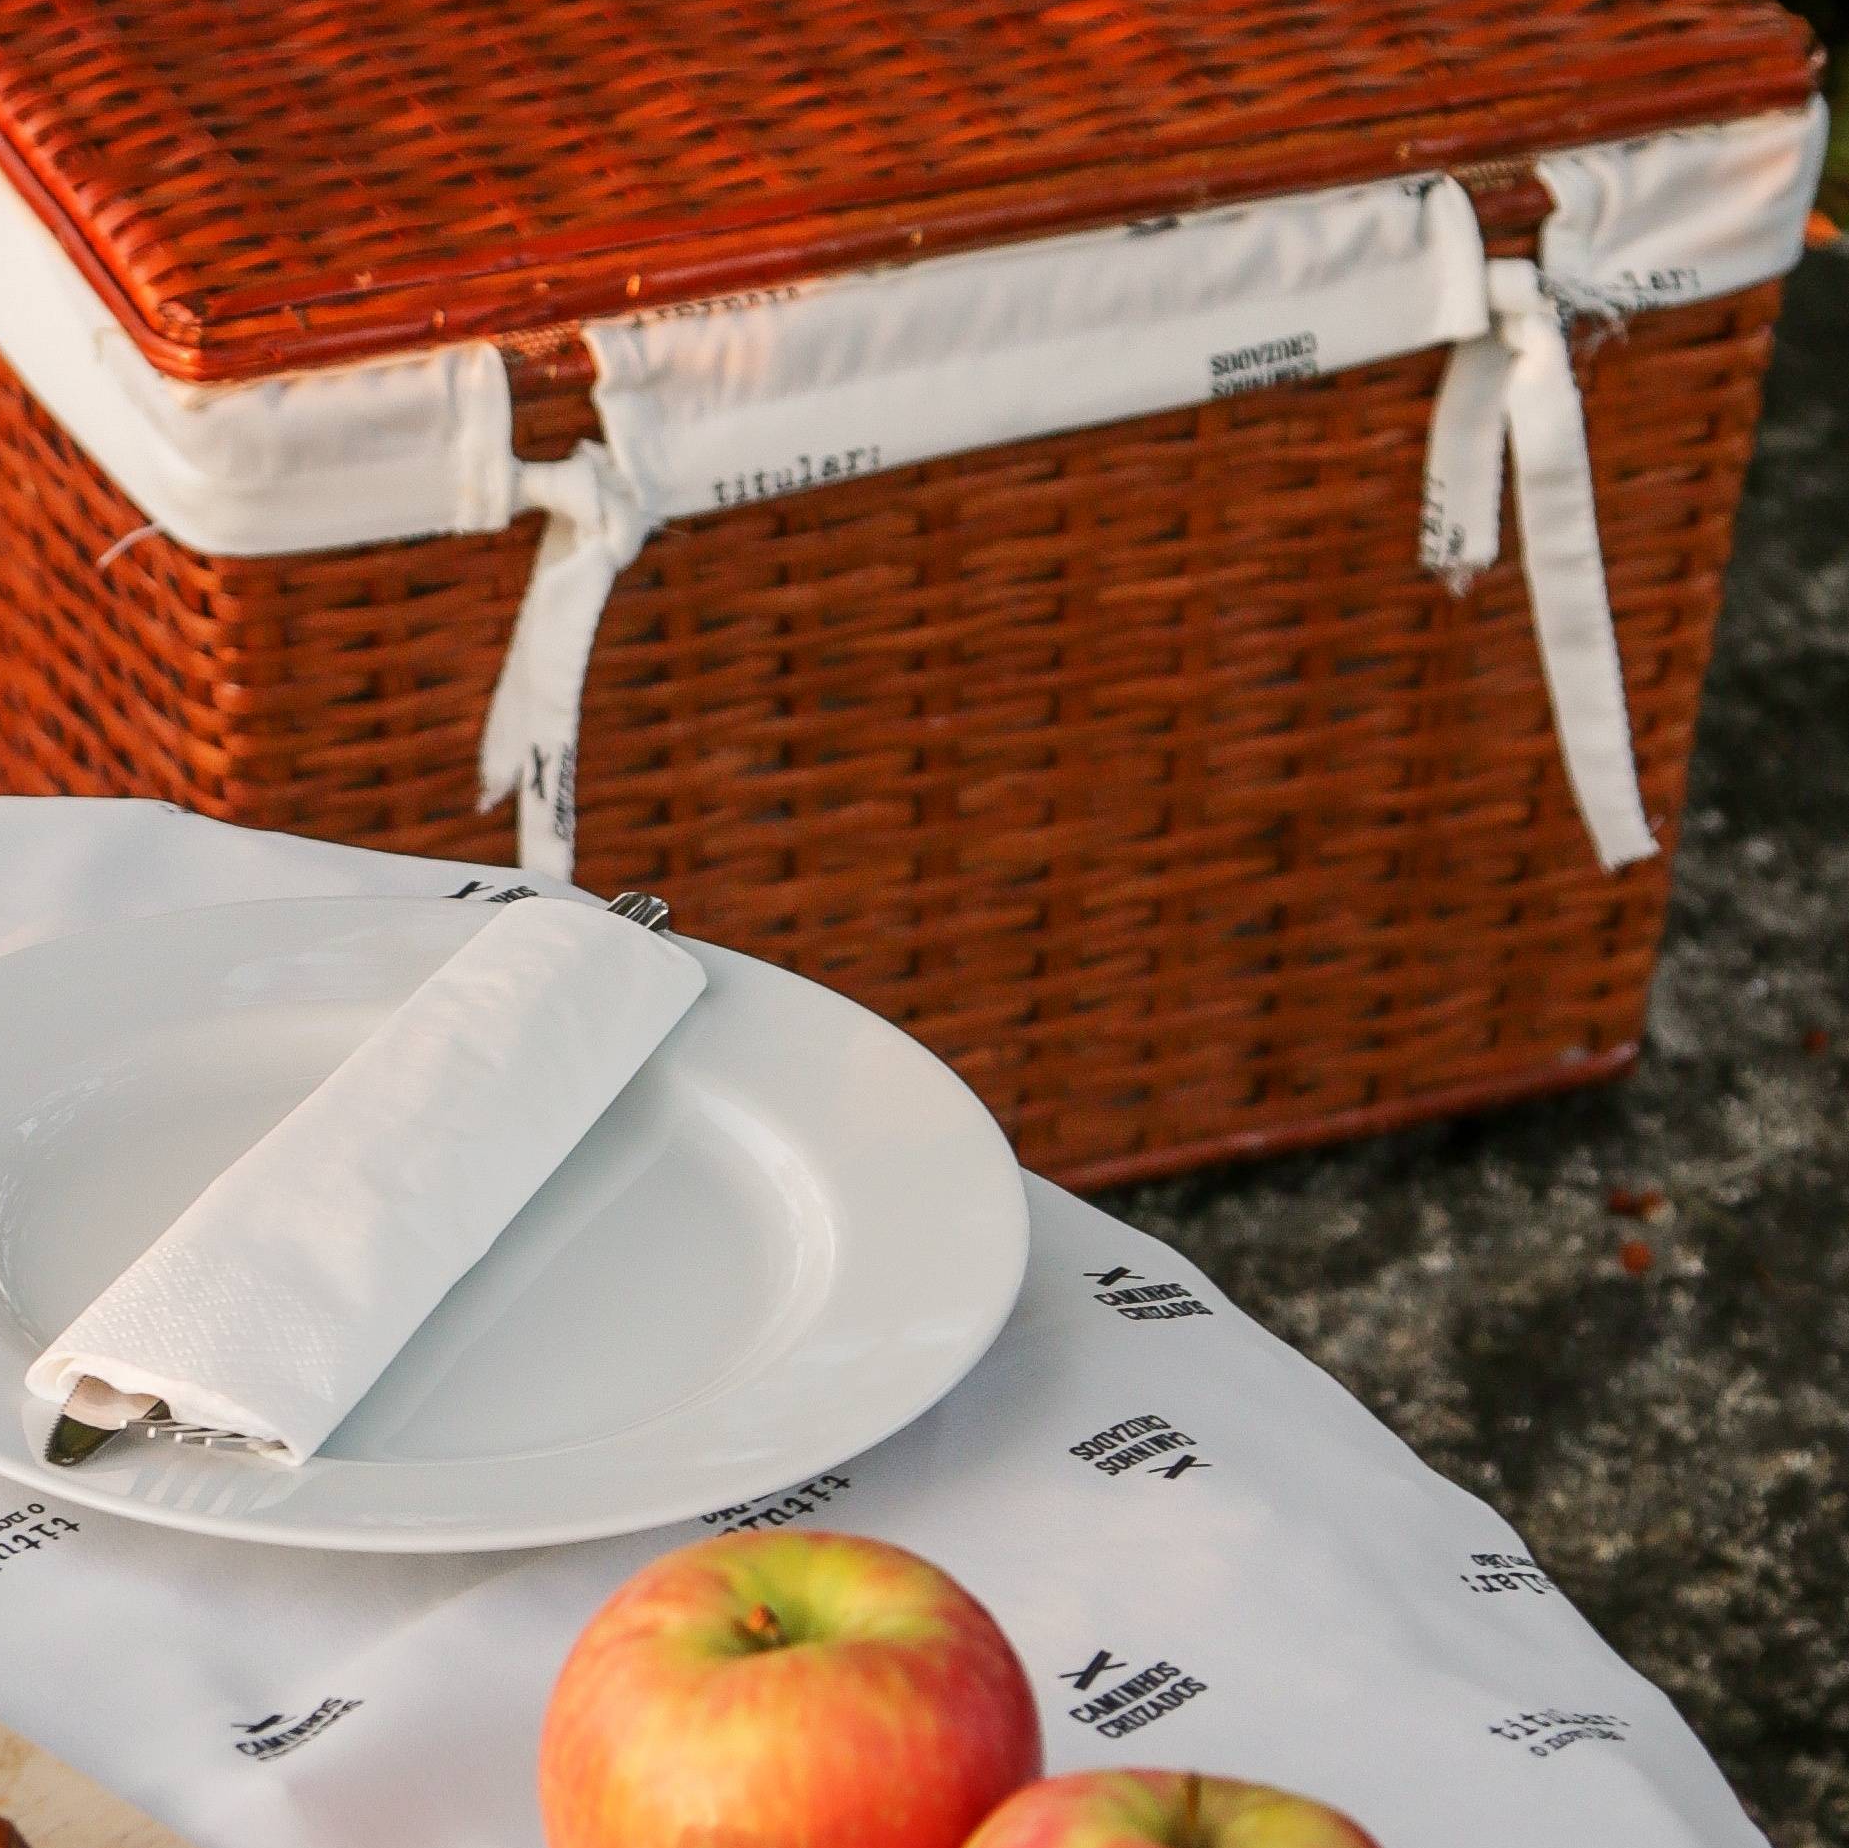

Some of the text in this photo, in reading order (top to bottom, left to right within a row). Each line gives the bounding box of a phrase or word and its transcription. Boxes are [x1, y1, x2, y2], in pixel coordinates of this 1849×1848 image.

[1094, 1283, 1193, 1306] CAMINHOS
[1117, 1301, 1214, 1320] CRUZADOS
[1069, 1415, 1171, 1461] CRUZADOS
[1095, 1432, 1197, 1476] CAMINHOS
[27, 1503, 45, 1514] o
[1069, 1661, 1181, 1724] CAMINHOS
[1096, 1676, 1208, 1739] CRUZADOS
